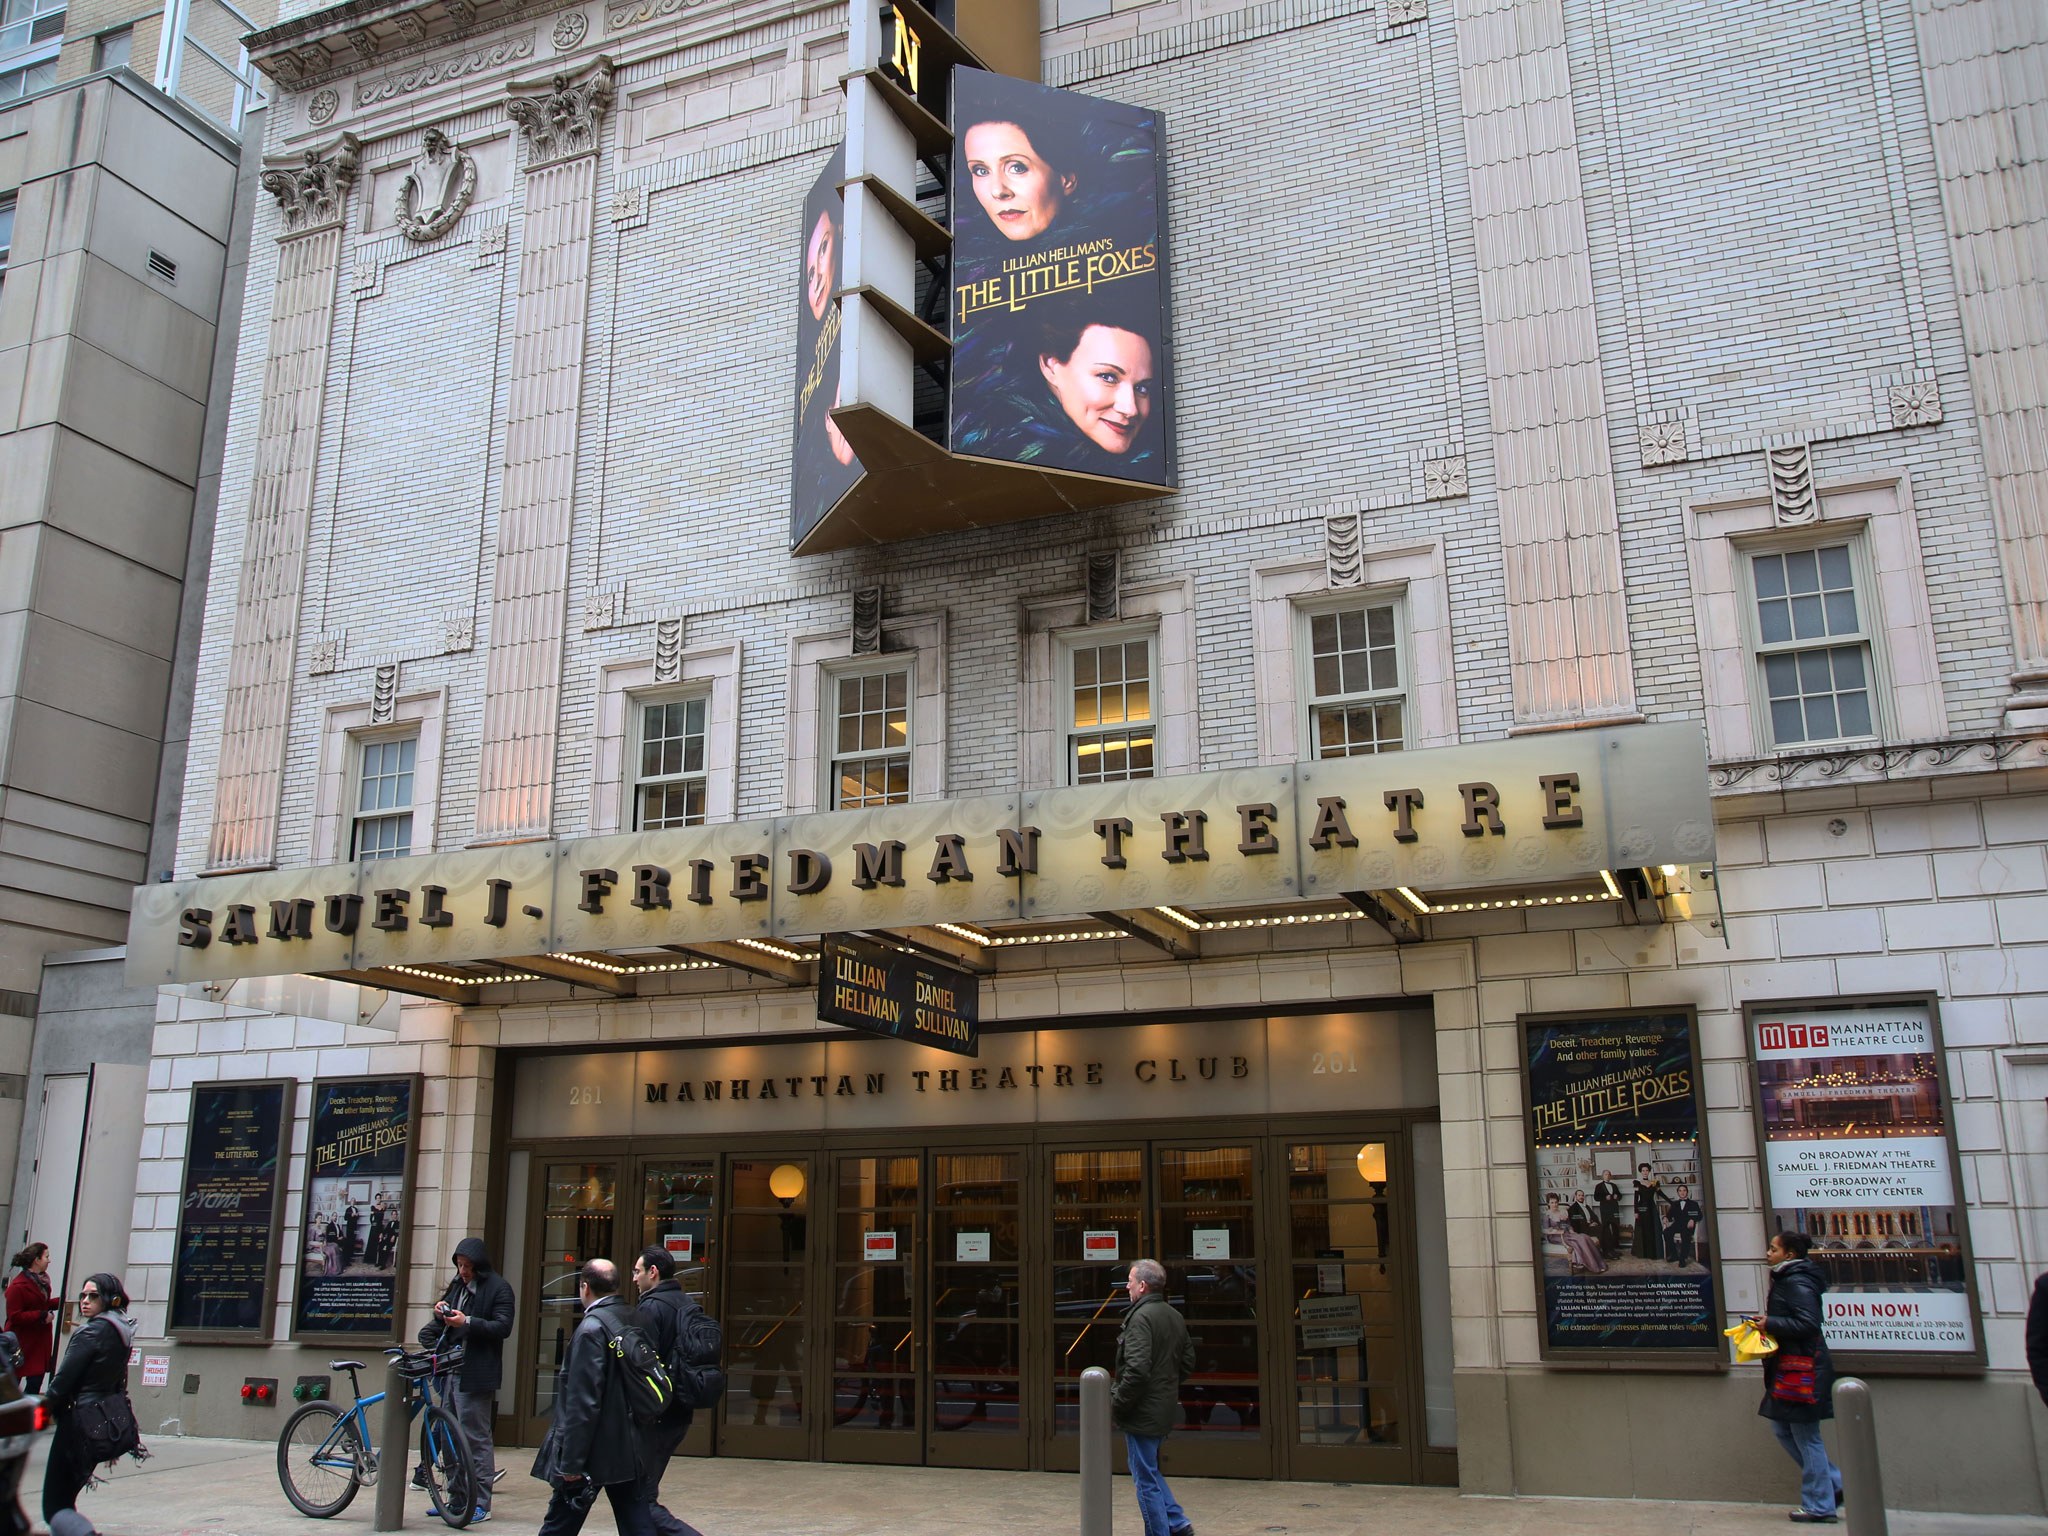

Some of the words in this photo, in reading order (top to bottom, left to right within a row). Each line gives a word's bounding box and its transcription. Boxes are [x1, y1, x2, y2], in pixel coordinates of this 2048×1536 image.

[890, 3, 921, 94] N
[1003, 251, 1047, 273] LILLIAN
[1049, 238, 1113, 263] HELLMAN'S
[956, 277, 1002, 324] THE
[1009, 260, 1081, 312] LITTLE
[1086, 243, 1157, 295] FOXES
[177, 884, 454, 949] SAMUEL
[484, 878, 543, 928] J.
[578, 825, 1042, 914] FRIEDMAN
[1095, 772, 1584, 870] THEATRE
[835, 956, 887, 992] LILLIAN
[834, 984, 899, 1023] HELLMAN
[915, 981, 957, 1013] DANIEL
[914, 1008, 969, 1042] SULLIVAN
[1831, 1021, 1923, 1035] MANHATTAN
[1549, 1039, 1578, 1049] Deceit.
[1579, 1036, 1623, 1047] Treachery.
[1625, 1034, 1664, 1045] Revenge.
[1760, 1025, 1827, 1048] MTC
[1832, 1035, 1887, 1047] THEATRE
[1892, 1034, 1925, 1044] CLUB
[1311, 1051, 1359, 1075] 261
[1556, 1052, 1573, 1062] And
[1575, 1050, 1598, 1060] other
[1600, 1049, 1627, 1060] family
[1629, 1047, 1659, 1057] values.
[644, 1072, 885, 1104] MANHATTAN
[912, 1062, 1103, 1092] THEATRE
[1135, 1056, 1249, 1083] CLUB
[1565, 1076, 1600, 1096] LILLIAN
[1600, 1065, 1654, 1087] HELLMAN'S
[330, 1097, 347, 1105] Deceit.
[348, 1096, 374, 1104] Treachery.
[375, 1095, 399, 1104] Revenge.
[569, 1085, 603, 1106] 261
[1532, 1099, 1567, 1139] THE
[1572, 1085, 1628, 1131] LITTLE
[1632, 1070, 1690, 1116] FOXES
[333, 1107, 344, 1115] And
[359, 1106, 376, 1114] family
[336, 1126, 358, 1140] LILLIAN
[358, 1118, 389, 1134] HELLMAN'S
[214, 1151, 226, 1159] THE
[226, 1151, 242, 1159] LITTLE
[242, 1150, 259, 1158] FOXES
[315, 1142, 337, 1173] THE
[338, 1133, 373, 1167] LITTLE
[374, 1122, 408, 1157] FOXES
[1799, 1152, 1816, 1160] ON
[1819, 1150, 1879, 1160] BROADWAY
[1894, 1150, 1911, 1158] THE
[1778, 1162, 1819, 1172] SAMUEL
[1823, 1162, 1831, 1172] J.
[1833, 1161, 1887, 1170] FRIEDMAN
[1890, 1160, 1936, 1169] THEATRE
[1809, 1176, 1892, 1186] OFF-BROADWAY
[1796, 1189, 1820, 1198] NEW
[1824, 1188, 1852, 1197] YORK
[1856, 1188, 1880, 1196] CITY
[1883, 1187, 1924, 1196] CENTER
[1827, 1303, 1865, 1319] JOIN
[1871, 1303, 1920, 1317] NOW!
[1556, 1324, 1569, 1332] Two
[1570, 1324, 1610, 1332] extraordinary
[1640, 1323, 1668, 1331] alternate
[1669, 1323, 1685, 1331] roles
[1840, 1320, 1855, 1328] CALL
[1857, 1320, 1868, 1328] THE
[1870, 1320, 1883, 1328] MTC
[1885, 1320, 1914, 1328] CLUBLINE
[1824, 1330, 1965, 1341] ATTANTHEATRECLUB.COM
